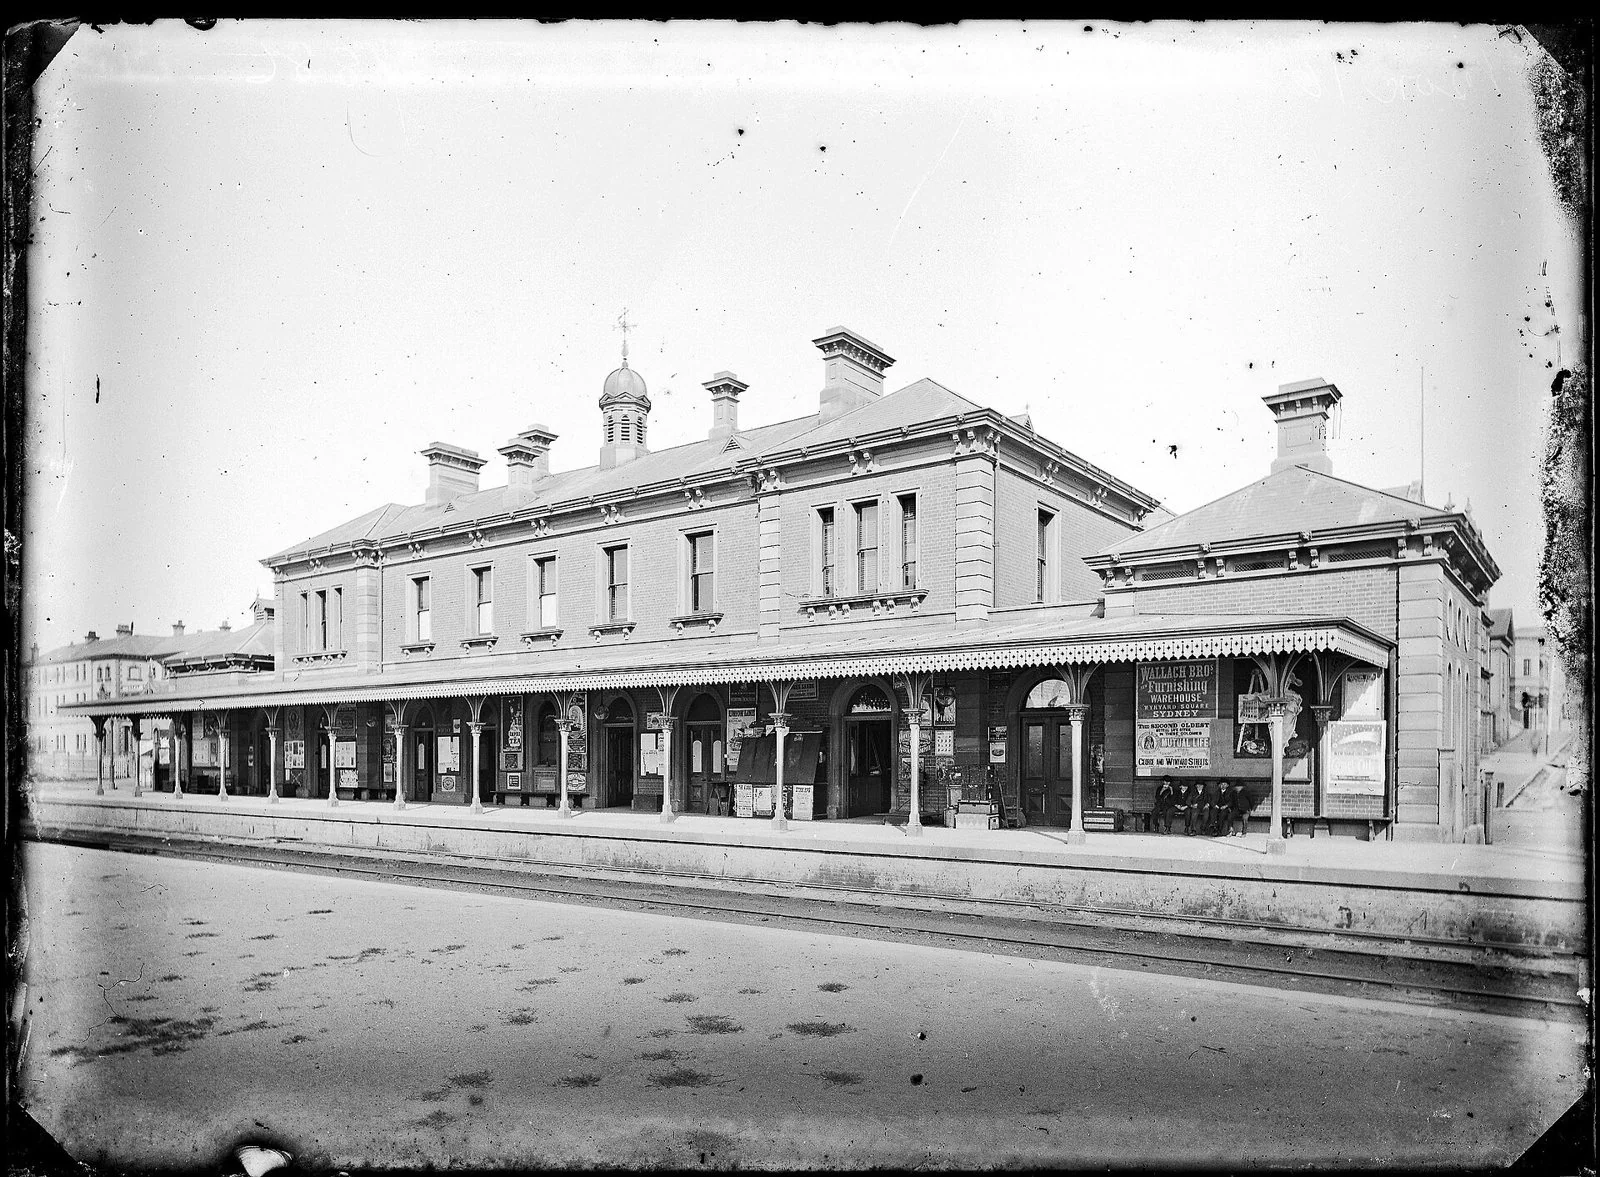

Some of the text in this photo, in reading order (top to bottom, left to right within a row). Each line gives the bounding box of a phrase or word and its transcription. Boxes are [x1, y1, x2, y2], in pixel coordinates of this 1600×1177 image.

[1140, 665, 1187, 684] WALLACH
[1147, 678, 1208, 695] Furnishing
[1150, 692, 1203, 704] WAREHOUSE
[1152, 710, 1199, 718] SYDNEY
[1161, 737, 1210, 748] MUTUAL LIFE
